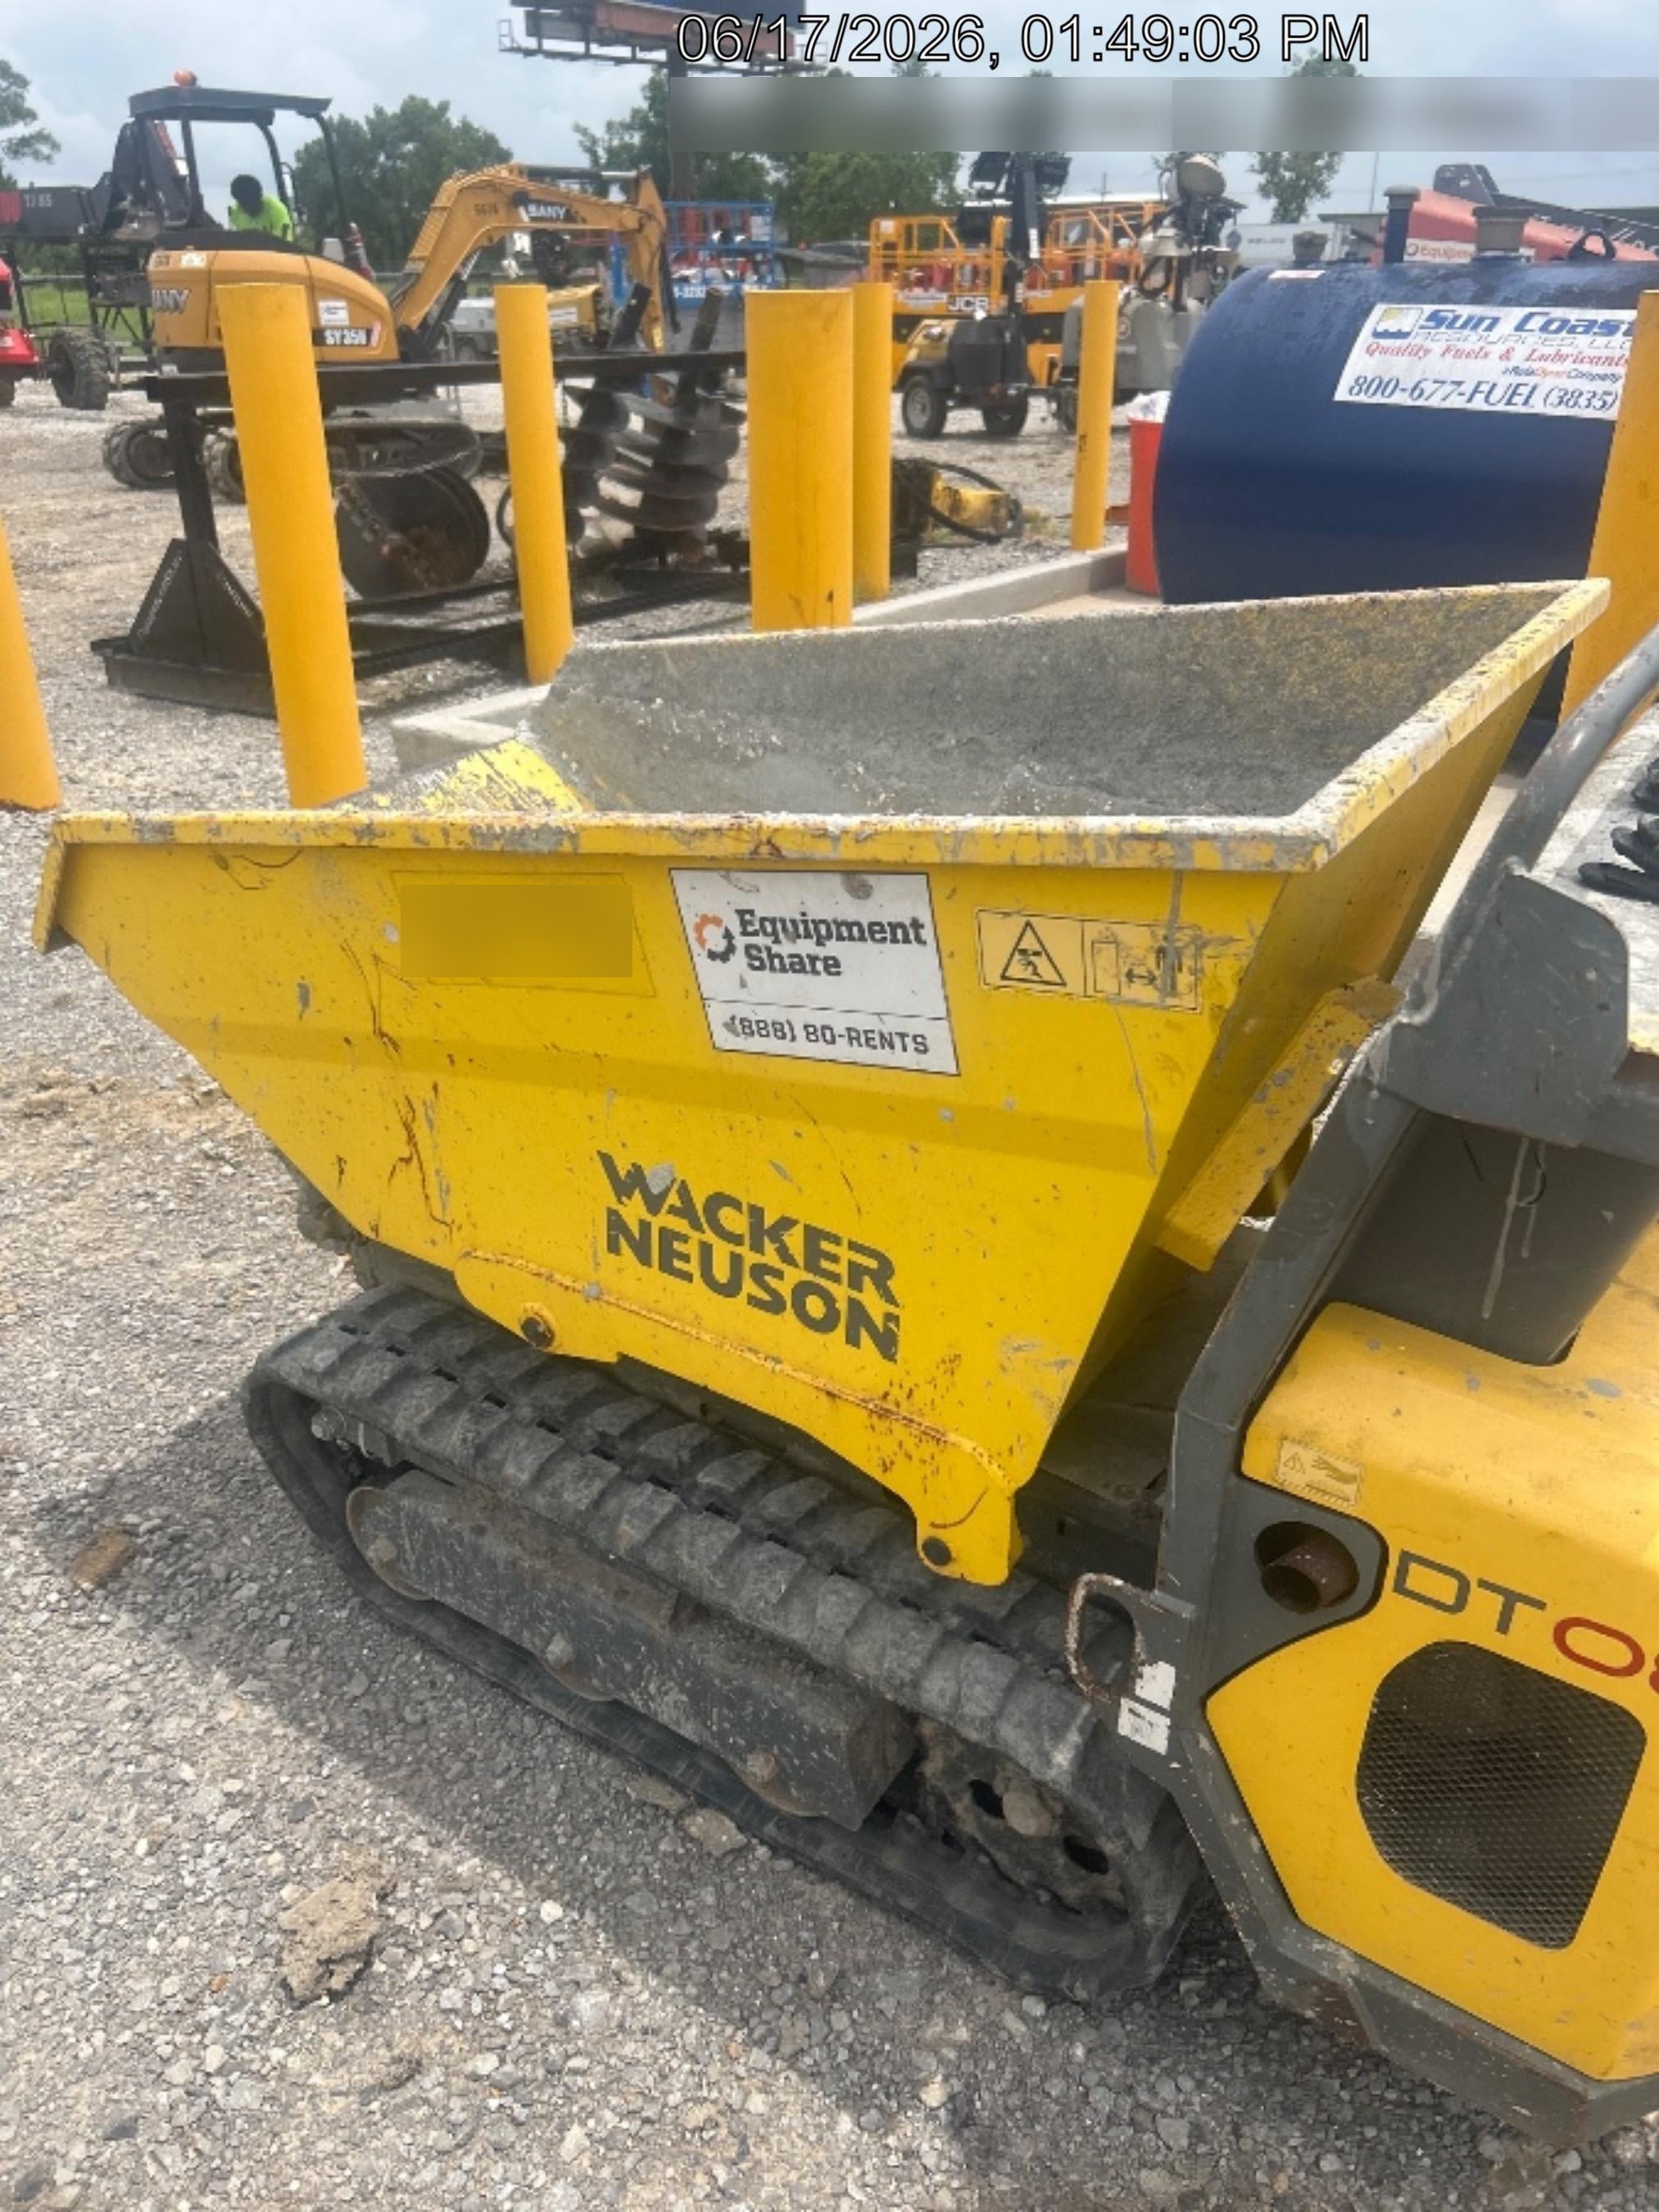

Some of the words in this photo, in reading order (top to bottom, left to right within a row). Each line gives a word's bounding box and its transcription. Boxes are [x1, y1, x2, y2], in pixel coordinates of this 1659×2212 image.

[528, 203, 566, 220] SANY
[1417, 309, 1501, 333] Sun
[1365, 342, 1432, 360] Quality
[1440, 344, 1491, 360] Fuels
[1498, 346, 1515, 362] &
[1349, 374, 1538, 407] 800-677-FUEL
[1543, 387, 1619, 412] (3835)
[1566, 369, 1622, 385] Company
[735, 909, 928, 947] Equipment
[744, 944, 842, 977] Share
[728, 1014, 796, 1043] (888)
[803, 1024, 930, 1055] 80-RENTS
[597, 1149, 900, 1308] WACKER
[606, 1206, 900, 1364] NEUSON
[1392, 1548, 1659, 1695] DT0
